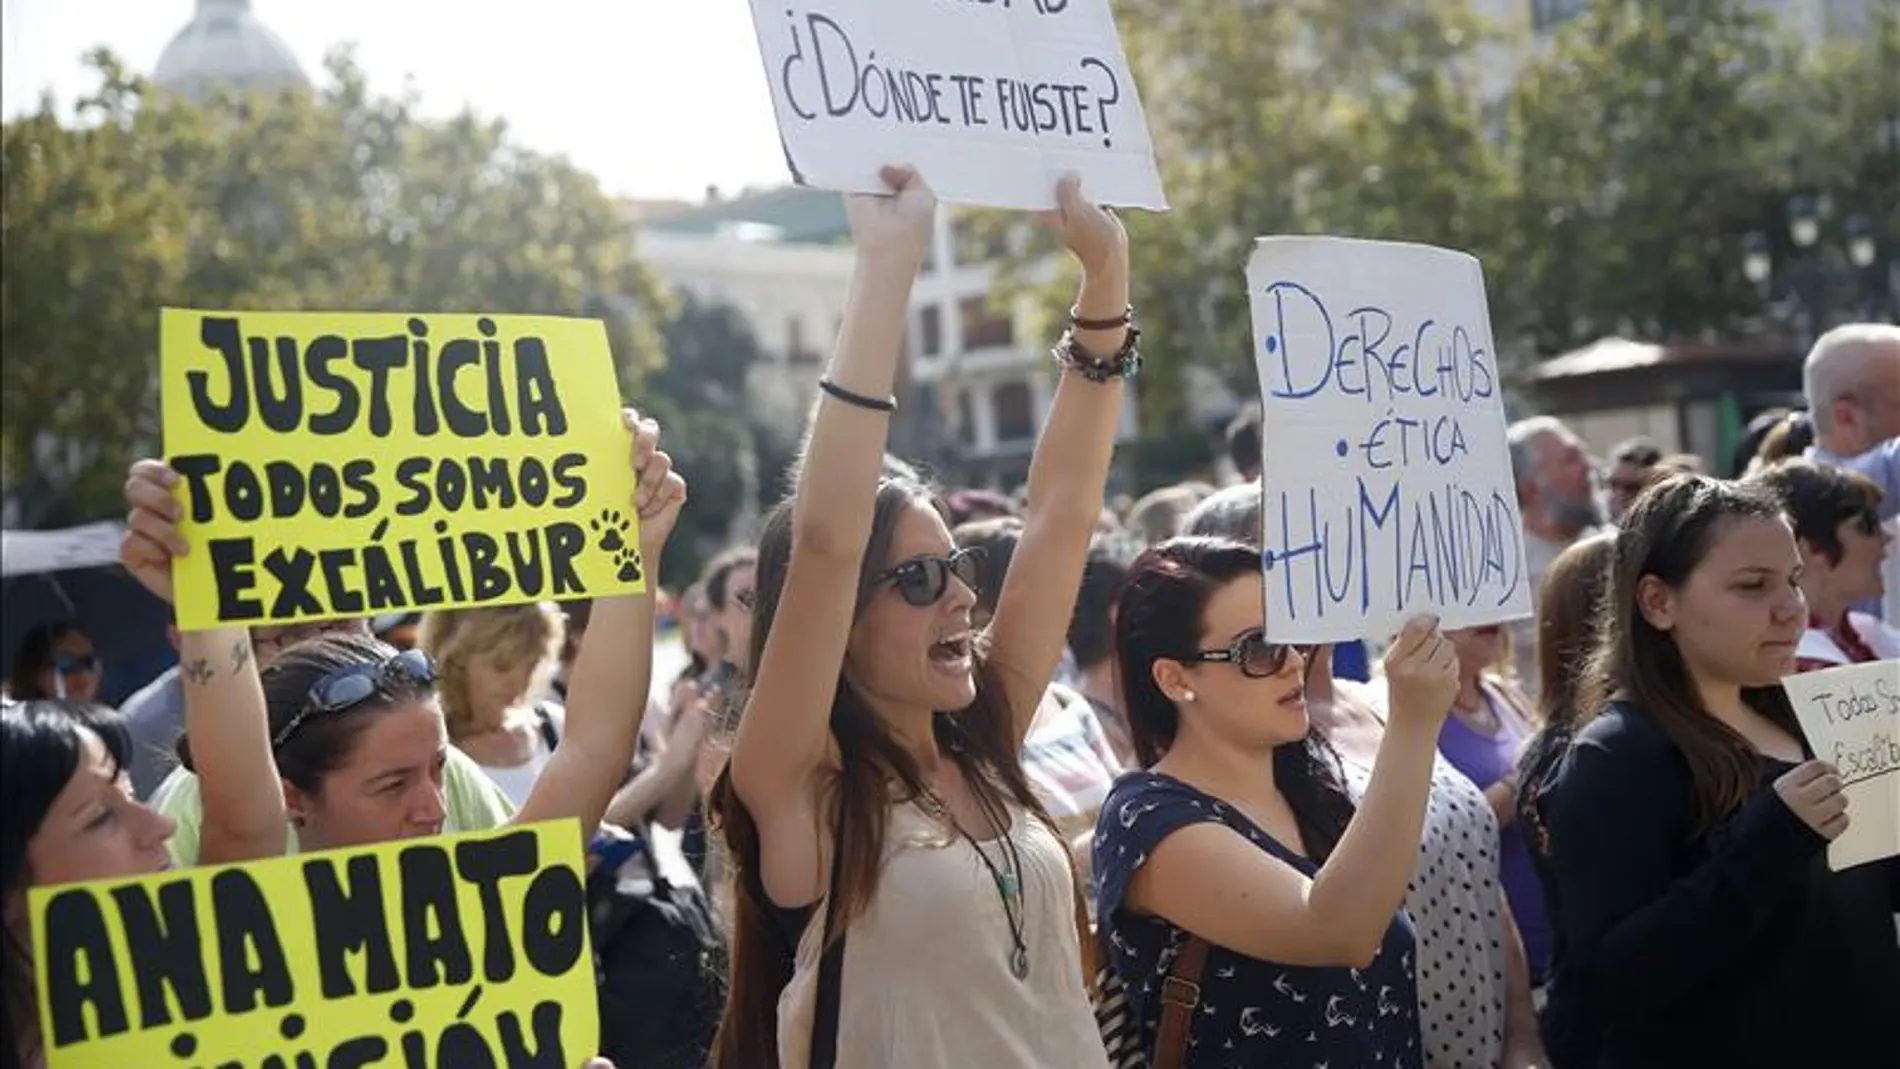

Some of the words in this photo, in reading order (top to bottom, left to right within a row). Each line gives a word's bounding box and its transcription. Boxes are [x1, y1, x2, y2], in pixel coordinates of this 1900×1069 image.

[782, 9, 950, 125] ¿DÓNDE
[949, 75, 988, 126] TE
[996, 57, 1119, 148] FUISTE?
[185, 316, 568, 438] JUSTICIA
[1265, 281, 1494, 403] DERECHOS
[170, 453, 381, 524] TODOS
[395, 452, 588, 517] SOMOS
[1358, 408, 1468, 469] ÉTICA
[208, 517, 587, 622] EXCÁLIBUR
[1270, 475, 1524, 621] HUMANIDAD
[44, 867, 295, 1049] ANA
[302, 830, 586, 1001] MATO
